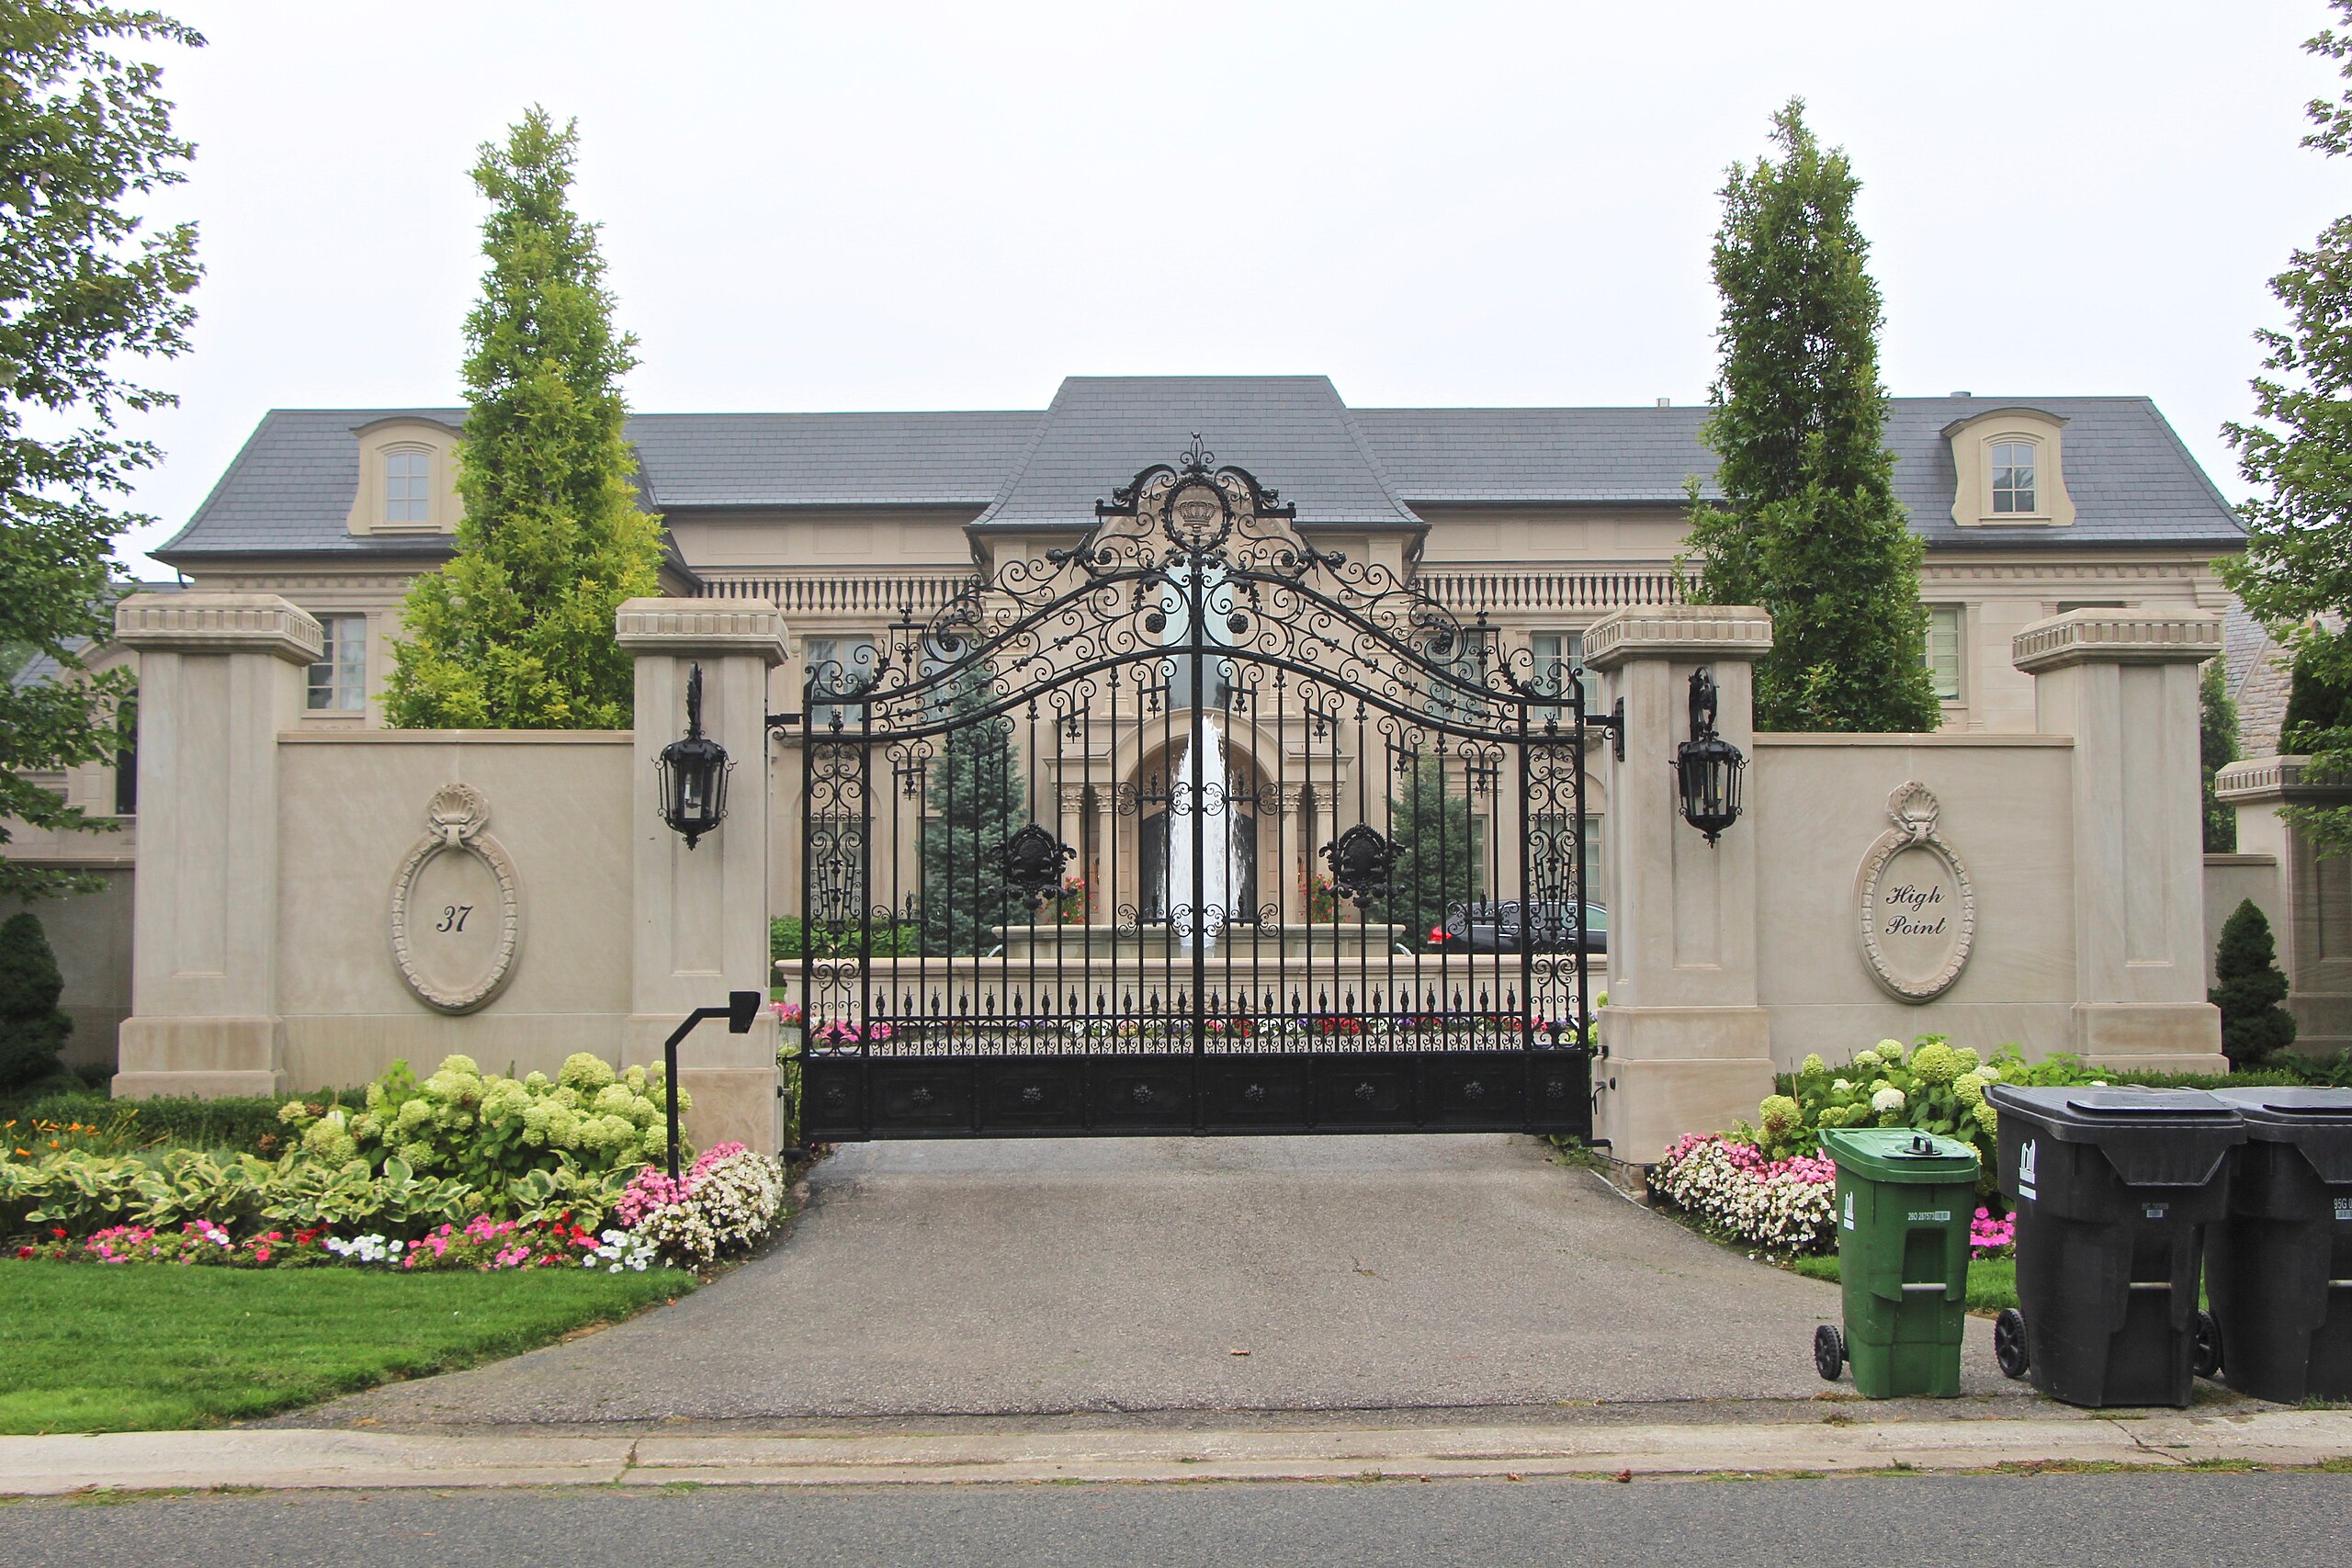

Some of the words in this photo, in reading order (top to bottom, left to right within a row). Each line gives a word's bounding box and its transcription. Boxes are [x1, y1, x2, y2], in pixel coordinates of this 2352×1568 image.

[1885, 884, 1945, 911] High
[435, 906, 473, 932] 37
[1885, 915, 1946, 935] Point
[2334, 1198, 2347, 1210] 95G
